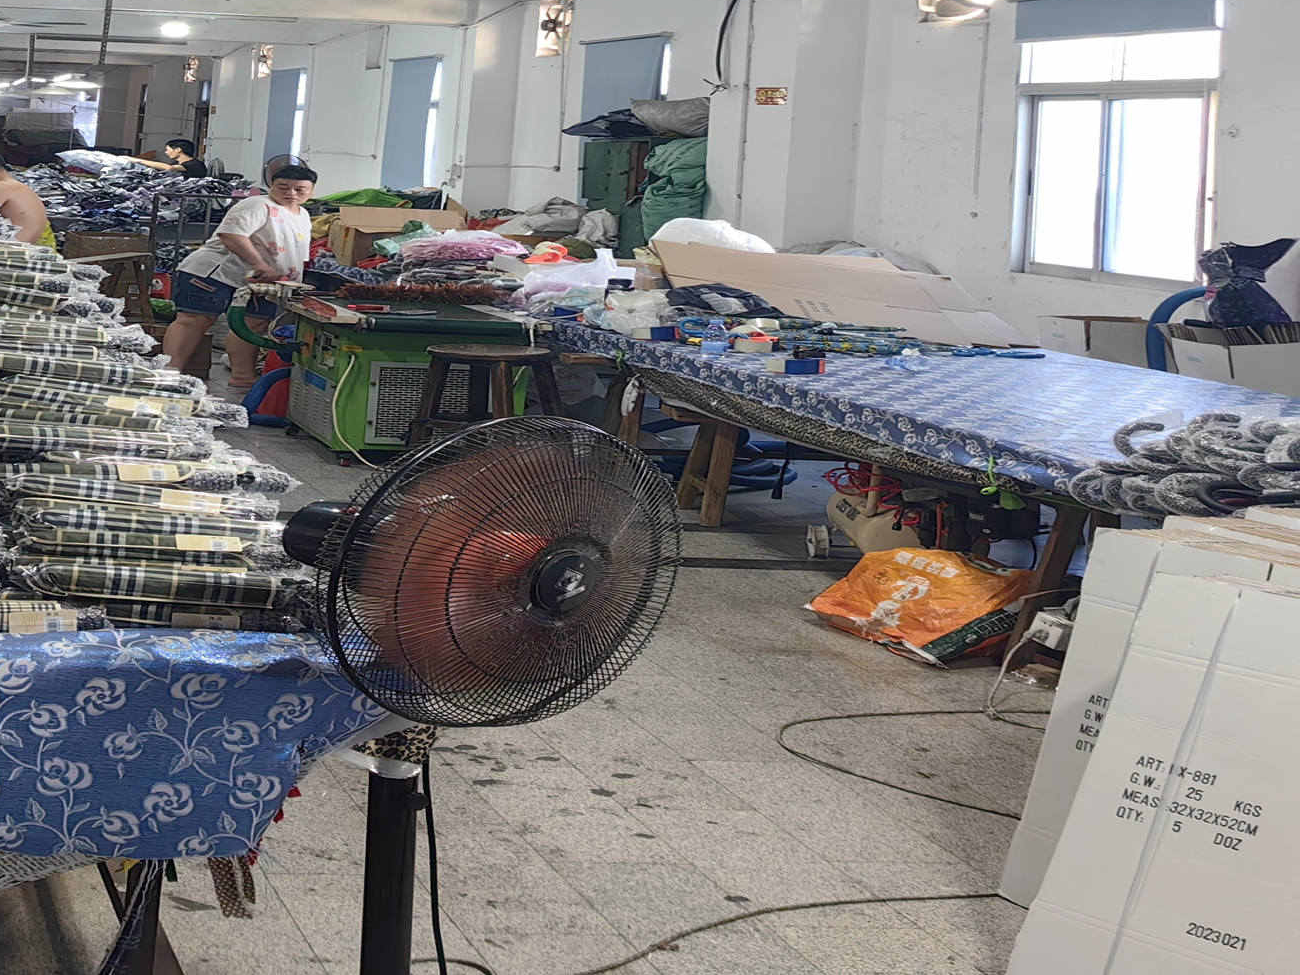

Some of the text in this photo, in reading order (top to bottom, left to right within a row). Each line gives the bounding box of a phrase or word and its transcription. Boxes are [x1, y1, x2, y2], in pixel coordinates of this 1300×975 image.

[1185, 786, 1205, 801] 25
[1232, 800, 1263, 818] KGS
[1171, 820, 1183, 833] 5
[1212, 832, 1244, 851] DOZ
